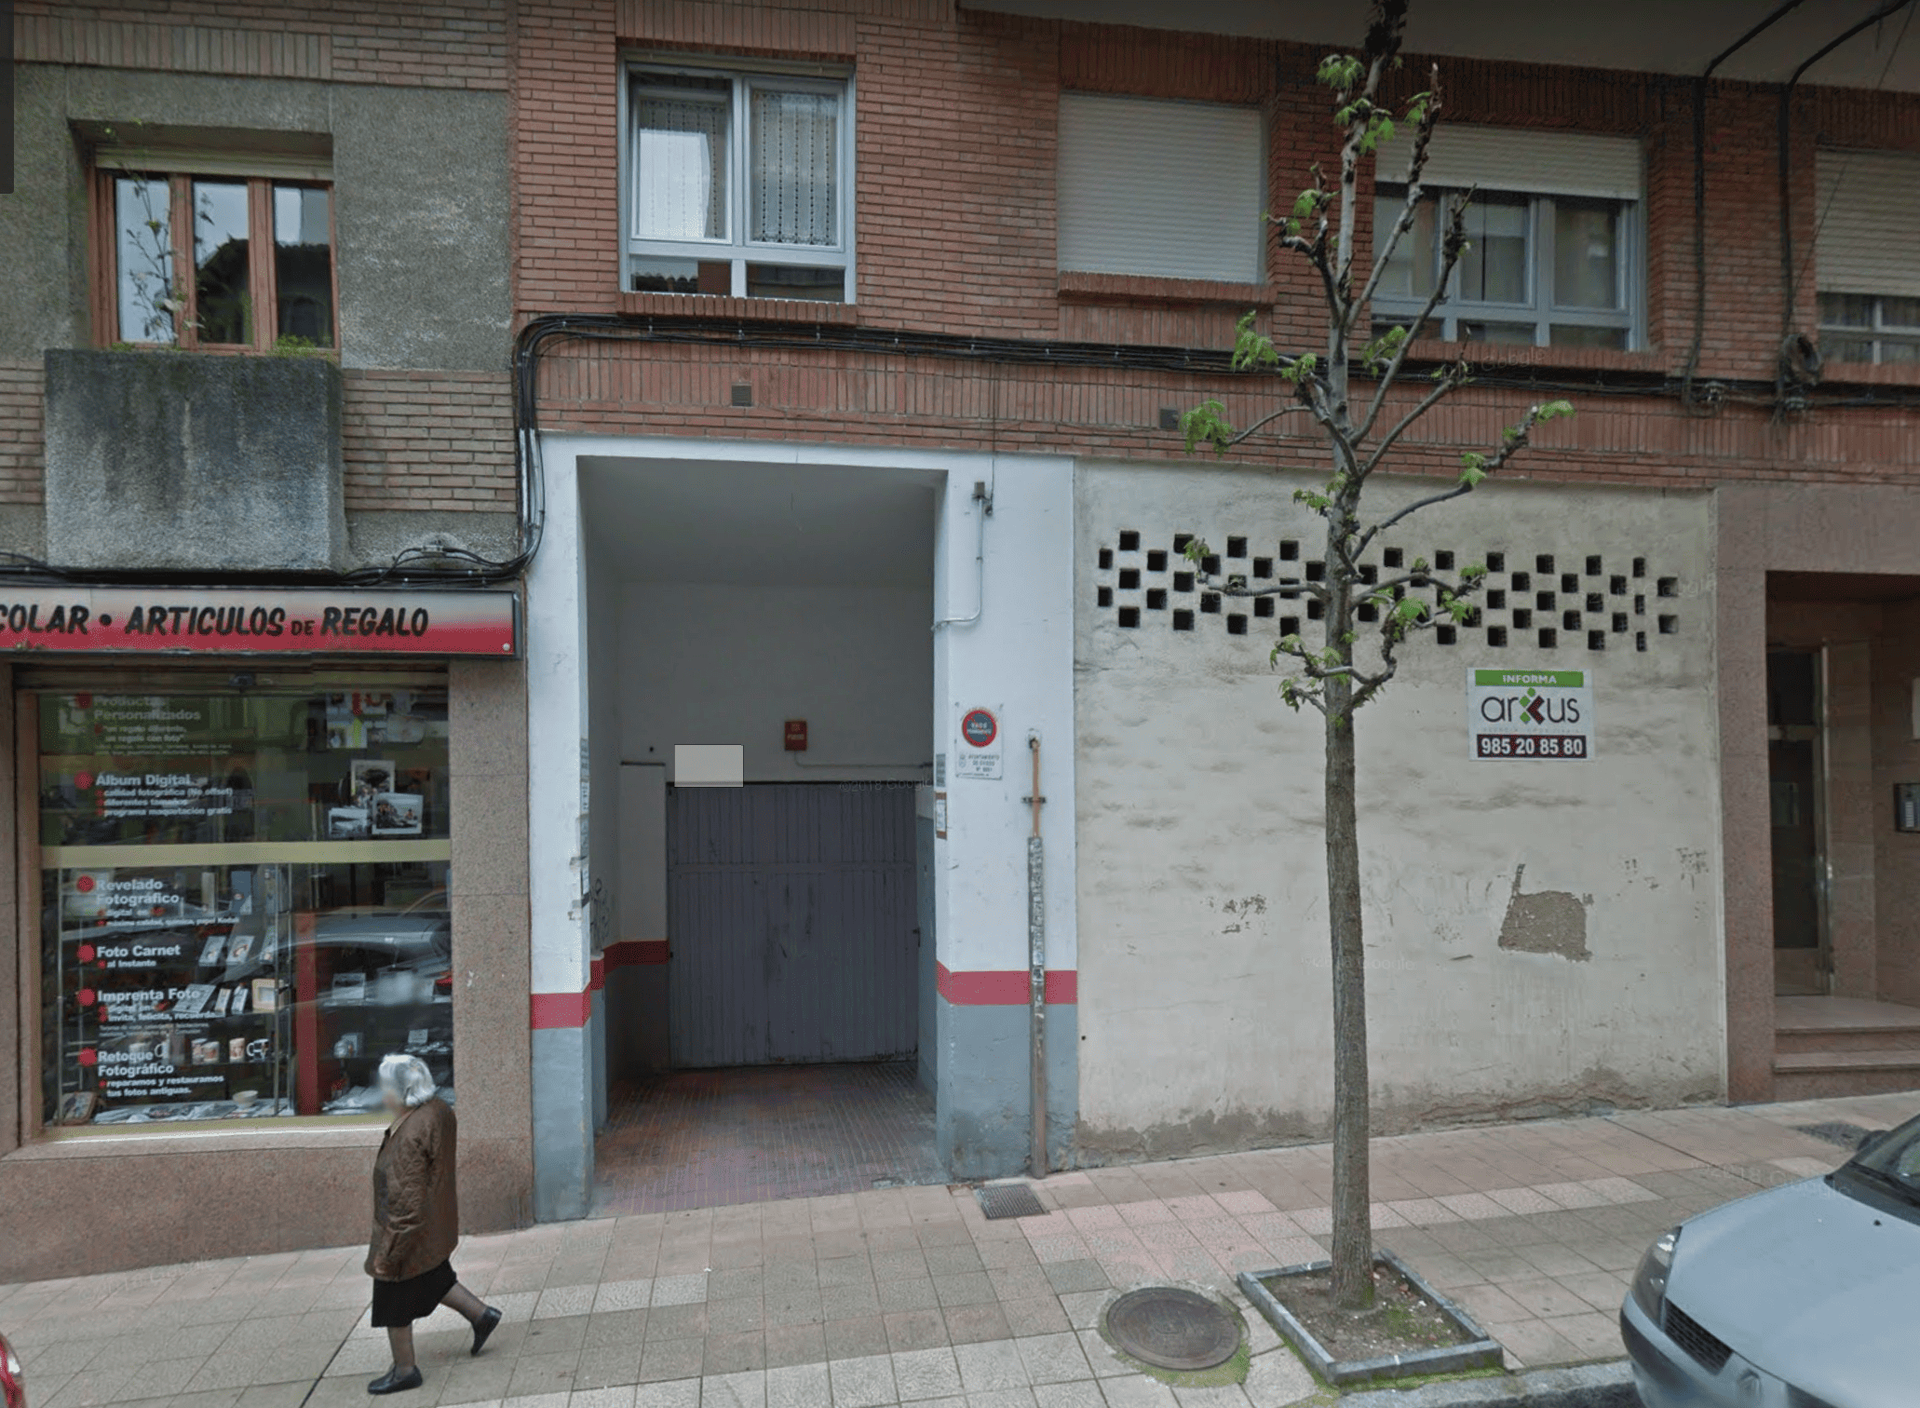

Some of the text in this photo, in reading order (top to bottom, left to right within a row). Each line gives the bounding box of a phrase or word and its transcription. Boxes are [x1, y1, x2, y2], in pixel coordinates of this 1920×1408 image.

[124, 605, 286, 637] ARTICULOS
[291, 619, 316, 636] DE
[320, 606, 429, 637] REGALO
[1503, 674, 1557, 684] INFORMA
[94, 709, 201, 720] Personalizados
[1481, 738, 1583, 755] 985 20 85 80
[145, 773, 190, 788] Digital
[104, 788, 136, 797] calidad
[97, 879, 163, 891] Revelado
[97, 892, 180, 907] Fotográfico
[97, 944, 181, 958] Foto Carnet
[97, 987, 201, 1004] Imprenta Foto
[97, 1051, 154, 1064] Retoque
[97, 1063, 174, 1078] Fotográfico
[107, 1075, 224, 1089] reparamos y restauramos
[106, 1089, 122, 1098] tus
[124, 1088, 148, 1097] fotos
